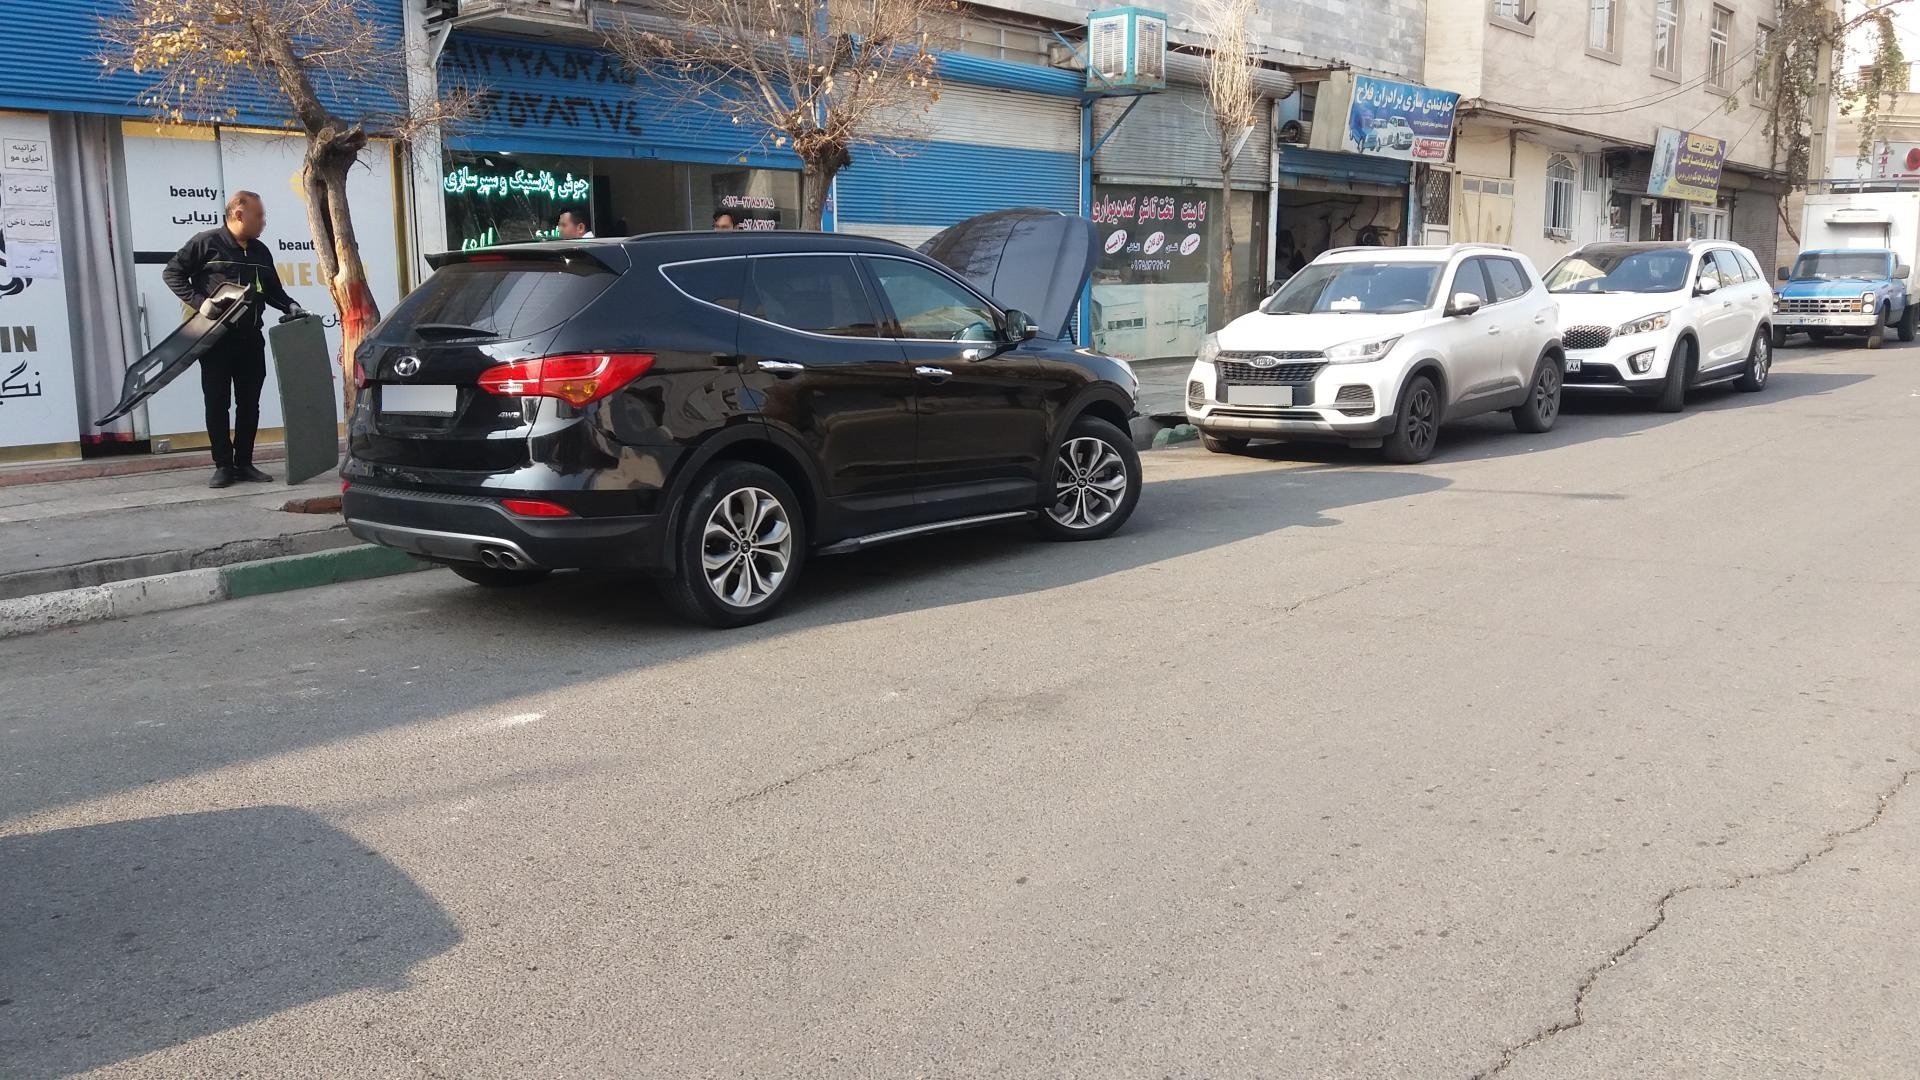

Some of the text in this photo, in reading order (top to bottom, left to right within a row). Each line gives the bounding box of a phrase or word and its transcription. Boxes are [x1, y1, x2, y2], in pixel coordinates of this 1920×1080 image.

[8, 185, 48, 194] کاشت مژه
[443, 165, 590, 200] جوش پلاستیک و سپر سازی
[170, 185, 217, 201] beauty
[1137, 195, 1159, 225] تاشو
[1157, 195, 1176, 221] تخت
[1181, 200, 1208, 229] کابینت
[6, 218, 52, 228] کاشت ناخن
[172, 210, 218, 225] زیبایی
[279, 239, 317, 251] beaut
[498, 411, 520, 419] 4WD
